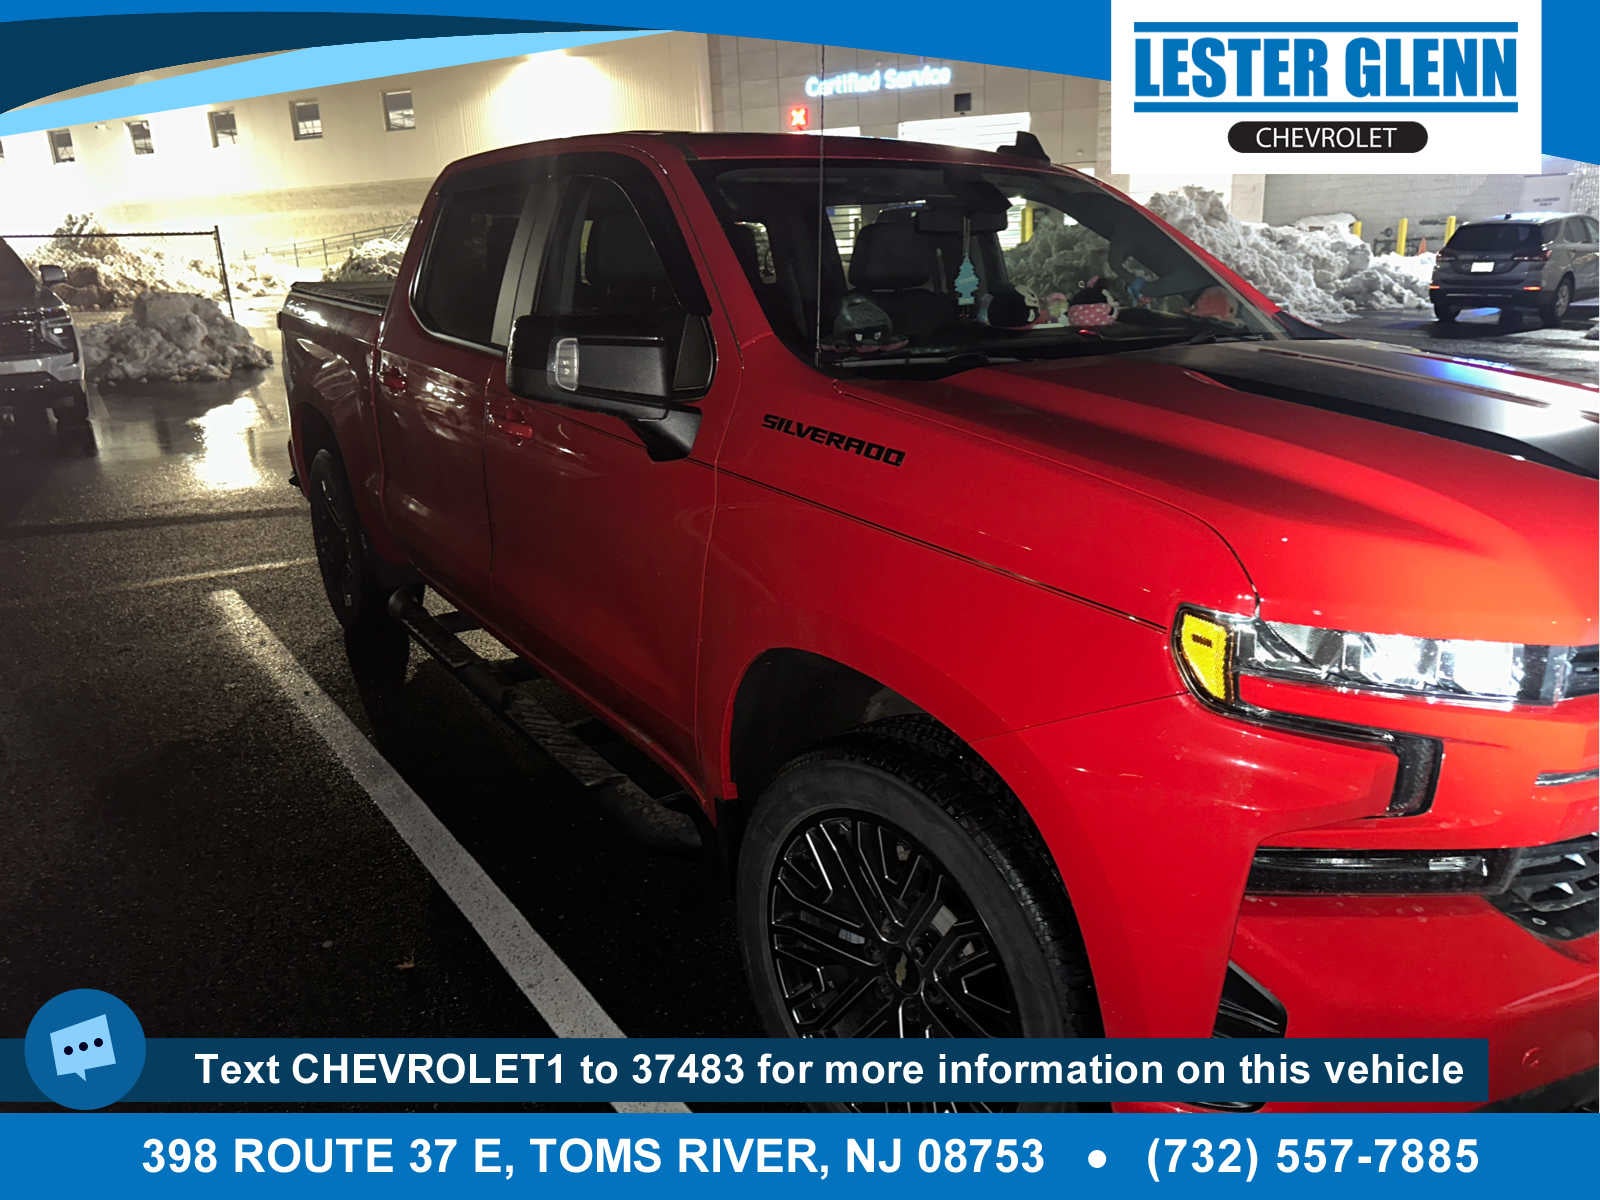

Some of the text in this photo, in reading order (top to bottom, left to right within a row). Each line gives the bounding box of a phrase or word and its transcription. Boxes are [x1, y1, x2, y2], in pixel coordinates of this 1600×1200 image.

[805, 65, 952, 98] Certified Service
[761, 413, 906, 467] SILVERADO
